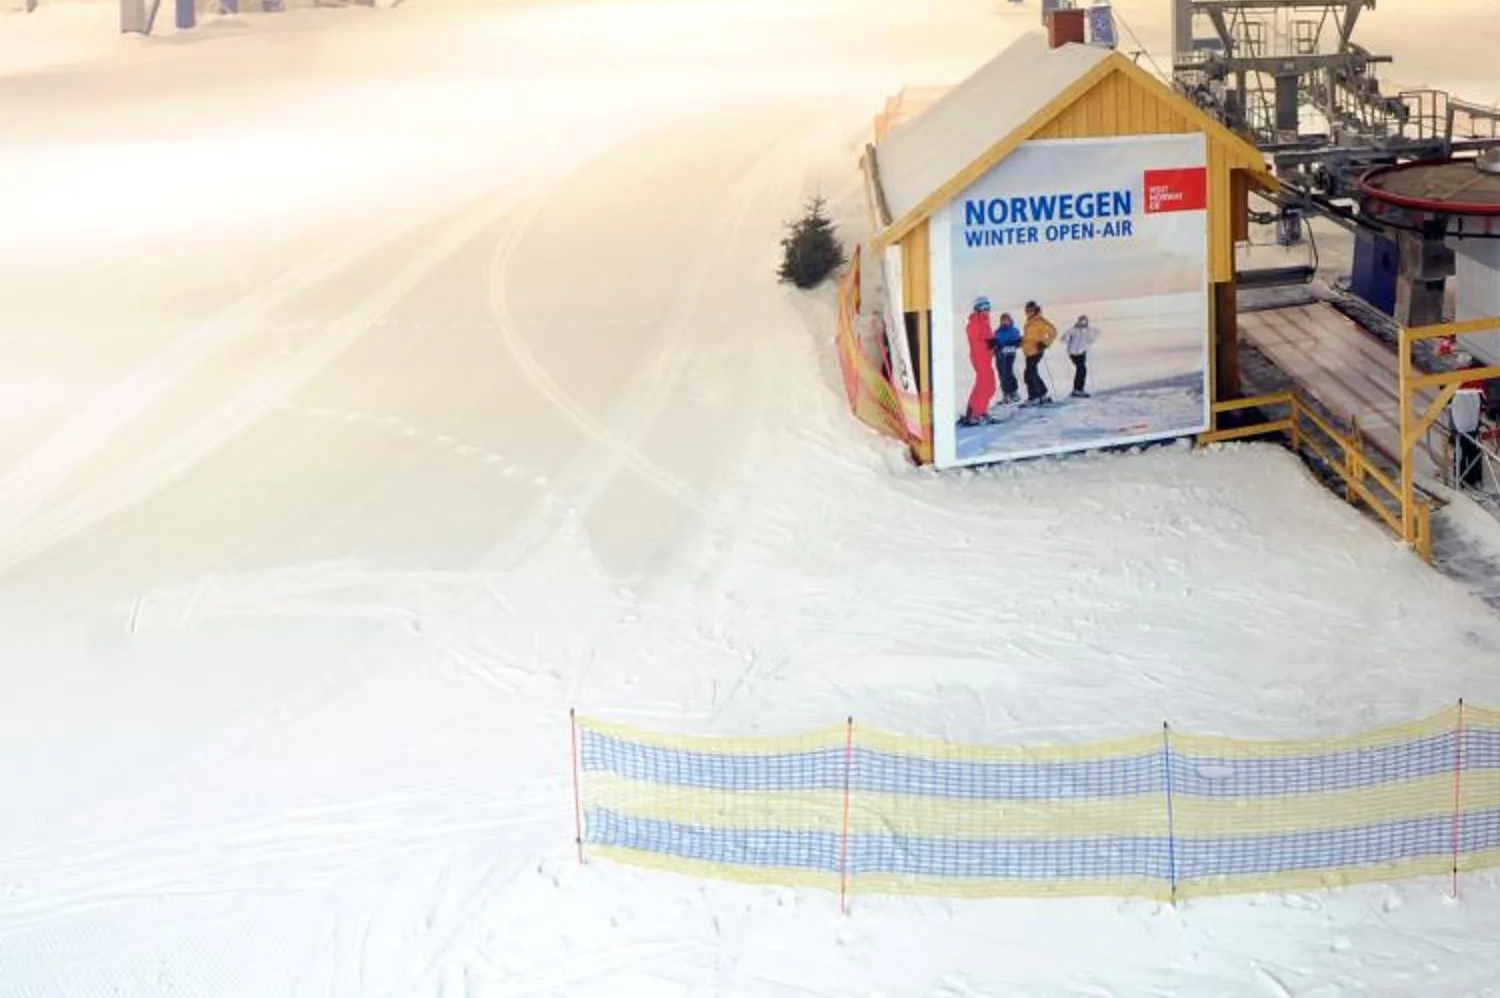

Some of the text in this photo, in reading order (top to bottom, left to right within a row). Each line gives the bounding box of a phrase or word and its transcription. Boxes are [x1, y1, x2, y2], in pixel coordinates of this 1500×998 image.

[965, 190, 1132, 226] NORWEGEN
[964, 220, 1133, 248] WINTER OPEN-AIR
